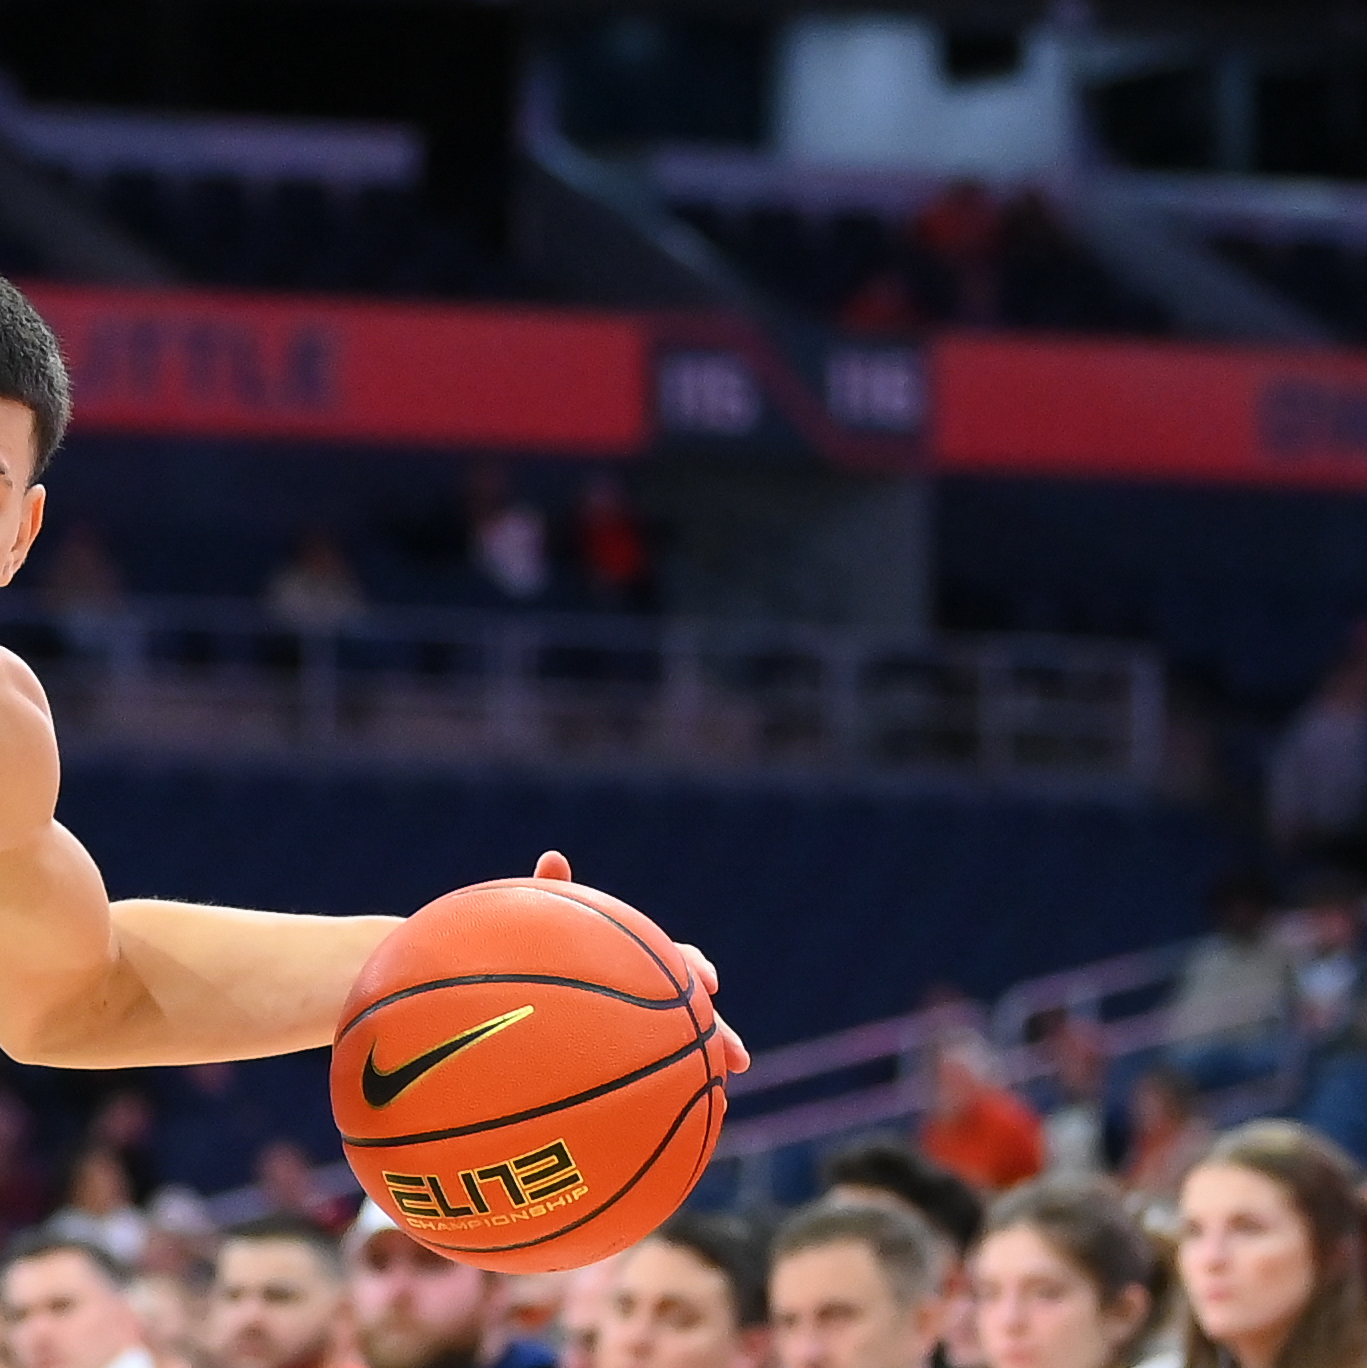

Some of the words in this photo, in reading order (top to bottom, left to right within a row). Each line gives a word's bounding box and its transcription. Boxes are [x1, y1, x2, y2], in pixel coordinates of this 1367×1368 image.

[77, 316, 333, 410] ITTLE
[381, 1137, 584, 1219] ELITE
[405, 1185, 590, 1232] CHAMPIONSHIP
